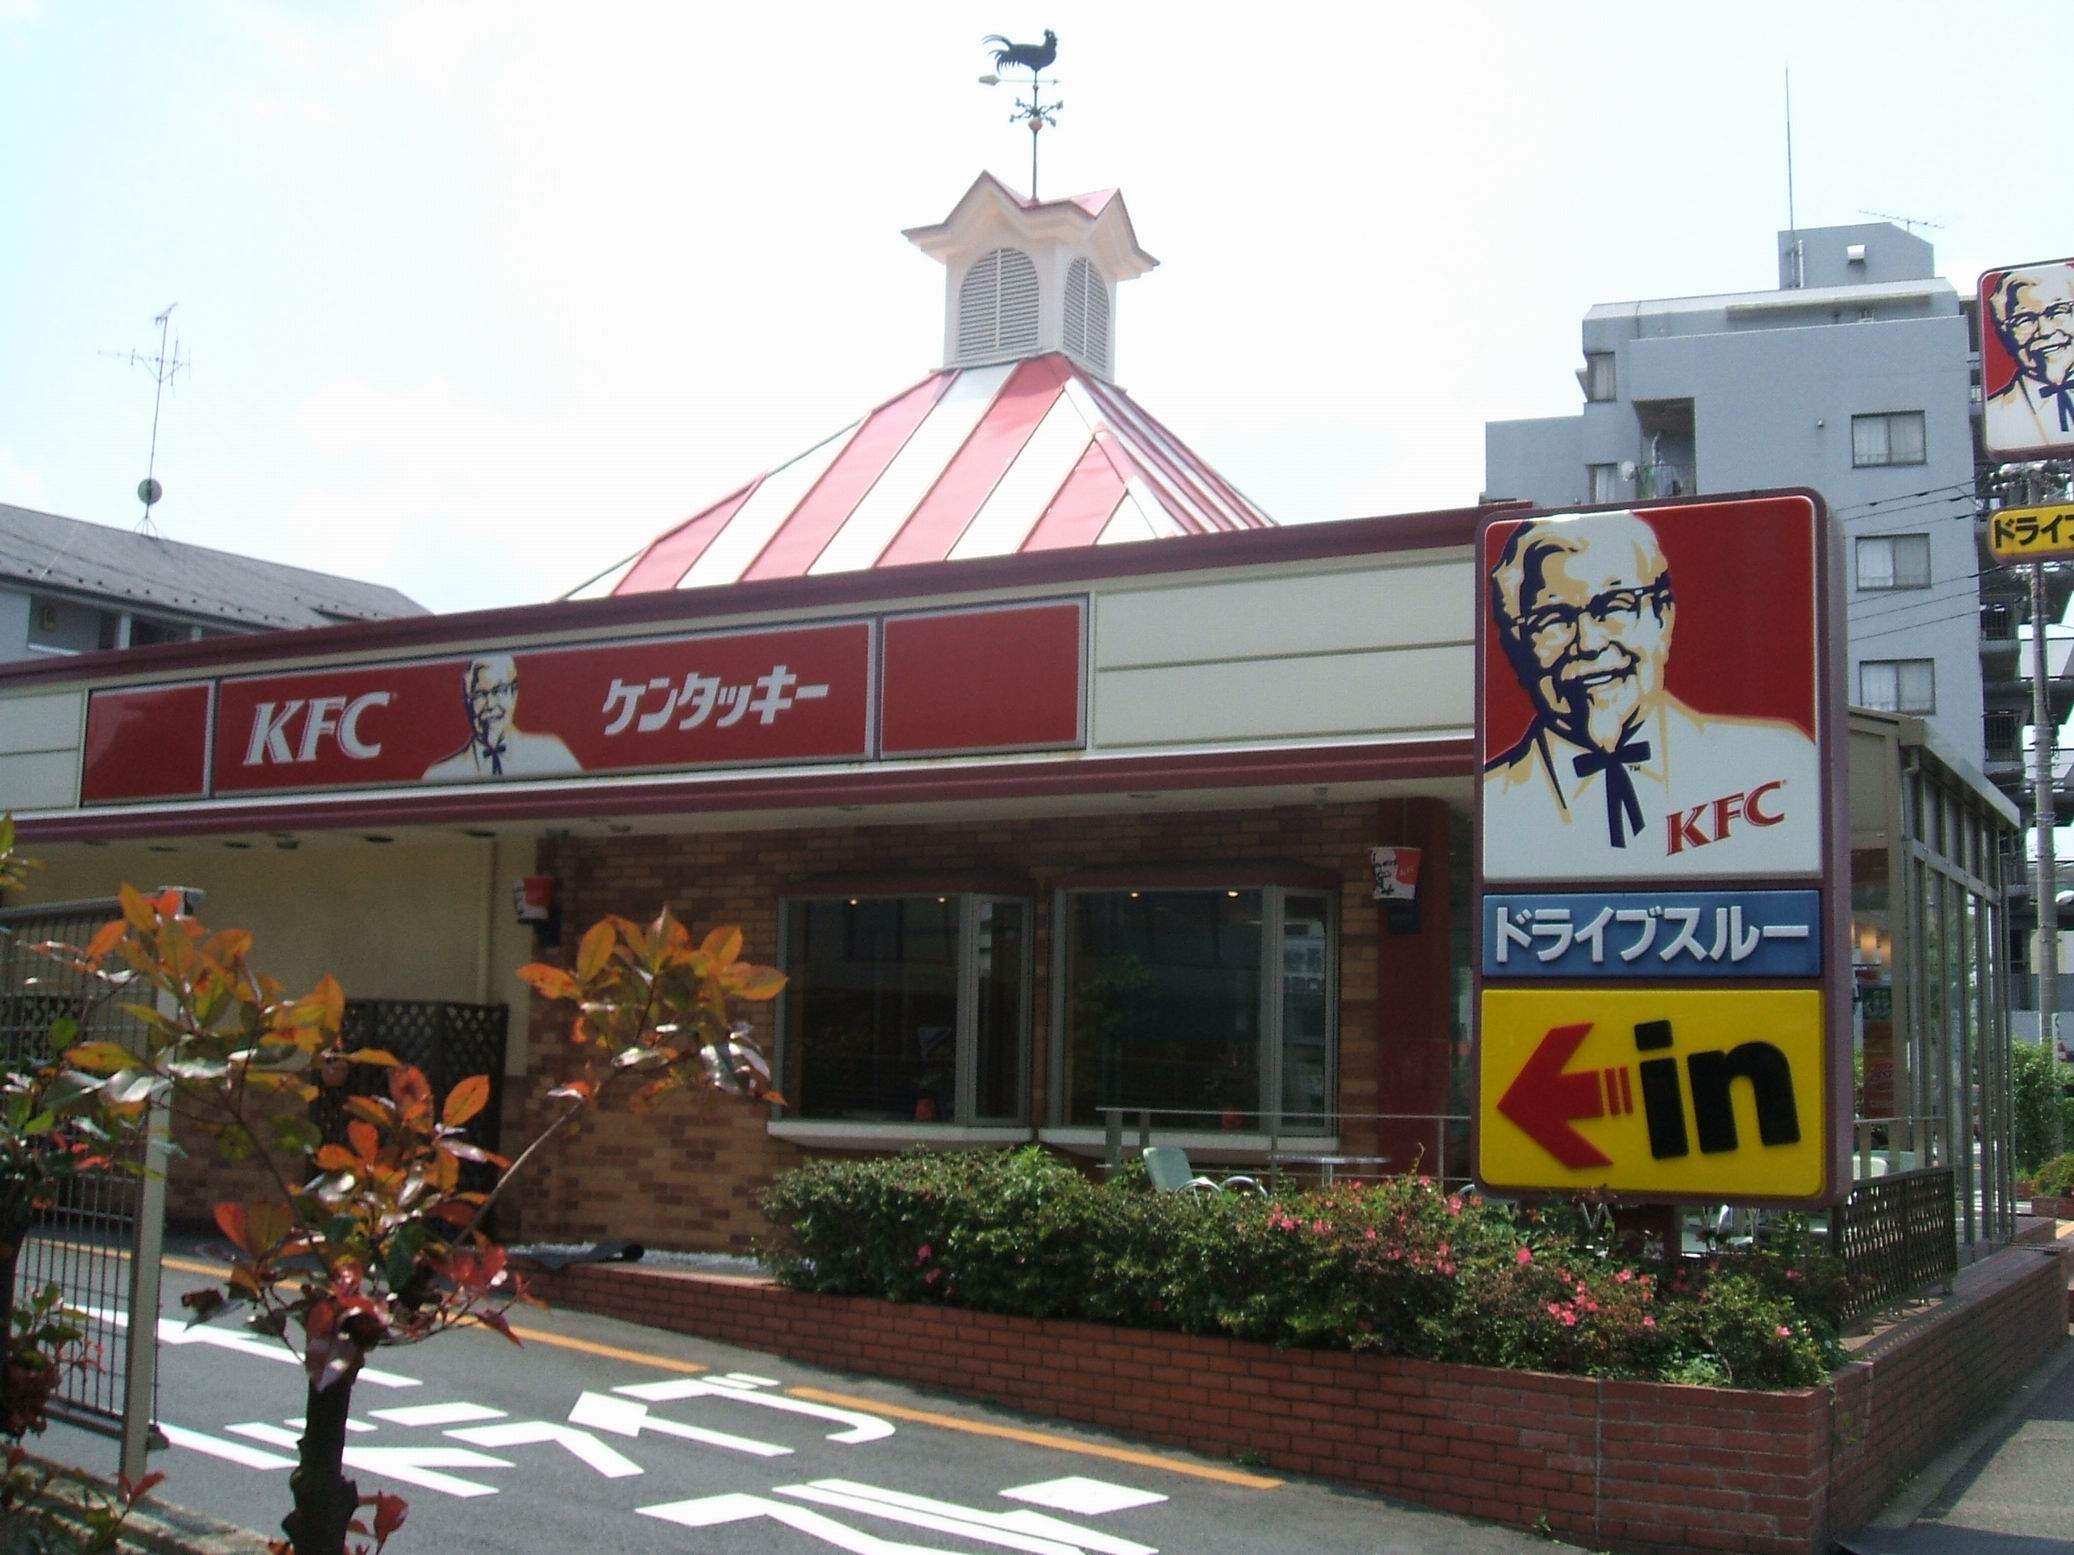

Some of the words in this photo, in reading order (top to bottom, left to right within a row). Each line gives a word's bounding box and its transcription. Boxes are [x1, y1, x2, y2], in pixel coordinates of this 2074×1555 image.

[242, 690, 392, 766] KFC
[602, 664, 829, 736] ケンタッキー
[1666, 779, 1786, 856] KFC
[1496, 905, 1809, 963] ドライブスルー
[1634, 1019, 1801, 1161] in
